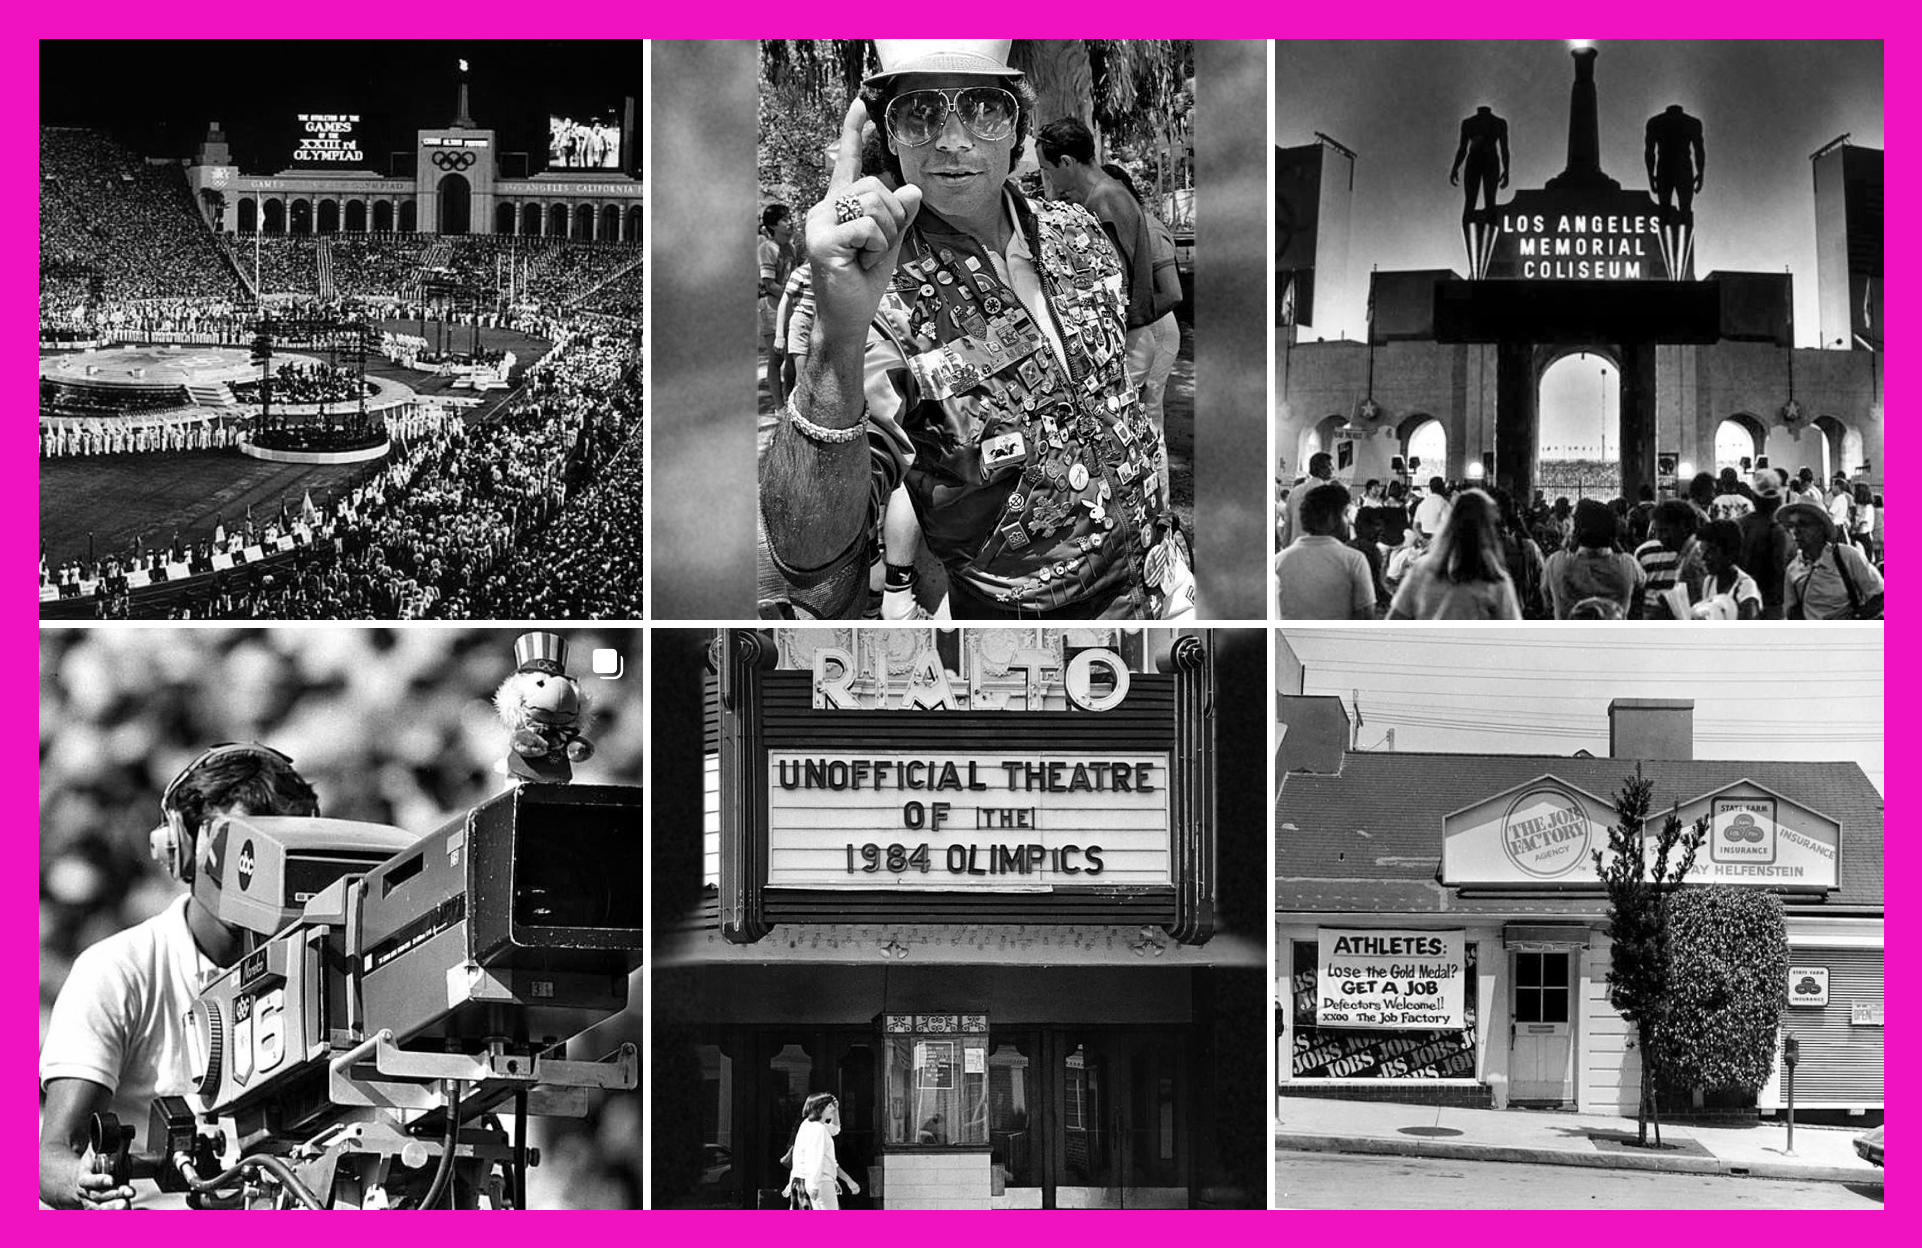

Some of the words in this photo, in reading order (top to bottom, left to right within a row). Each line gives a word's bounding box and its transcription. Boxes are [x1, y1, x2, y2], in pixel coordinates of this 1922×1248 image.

[305, 121, 352, 132] GAMES
[299, 138, 341, 150] XXIII
[293, 149, 363, 161] OLYMPIAD
[1503, 215, 1545, 233] LOS
[1557, 215, 1660, 234] ANGELES
[1519, 238, 1645, 256] MEMORIAL
[1524, 261, 1640, 279] COLISEUM
[812, 645, 1131, 712] RIALTO
[778, 758, 987, 792] UNOFFICIAL
[1001, 760, 1155, 793] THEATRE
[903, 800, 951, 832] OF
[981, 807, 1031, 829] THE
[1721, 804, 1744, 812] STATE
[1746, 804, 1768, 812] FARM
[1508, 816, 1547, 840] THE
[1547, 806, 1584, 828] JOB
[1510, 820, 1585, 856] FACTORY
[1779, 828, 1836, 861] INSURANCE
[846, 842, 932, 874] 1984
[945, 843, 1105, 876] OLIMPICS
[1535, 844, 1570, 862] AGENCY
[1720, 846, 1768, 854] INSURANCE
[1688, 865, 1709, 875] AY
[1714, 865, 1805, 877] HELFENSTEIN
[1333, 936, 1448, 956] ATHLETES:
[1327, 962, 1362, 979] Lose
[1366, 965, 1388, 978] the
[1390, 963, 1416, 979] Gold
[1419, 963, 1459, 979] Medal?
[1340, 980, 1378, 996] GET
[1381, 981, 1399, 995] A
[1404, 980, 1439, 997] JOB
[1323, 997, 1382, 1012] Defectors
[1383, 996, 1445, 1011] Welcome!!
[1356, 1012, 1377, 1023] The
[1379, 1012, 1399, 1025] Job
[1401, 1012, 1451, 1025] Factory
[1293, 1042, 1342, 1075] JOBS
[1326, 1049, 1375, 1078] JOBS
